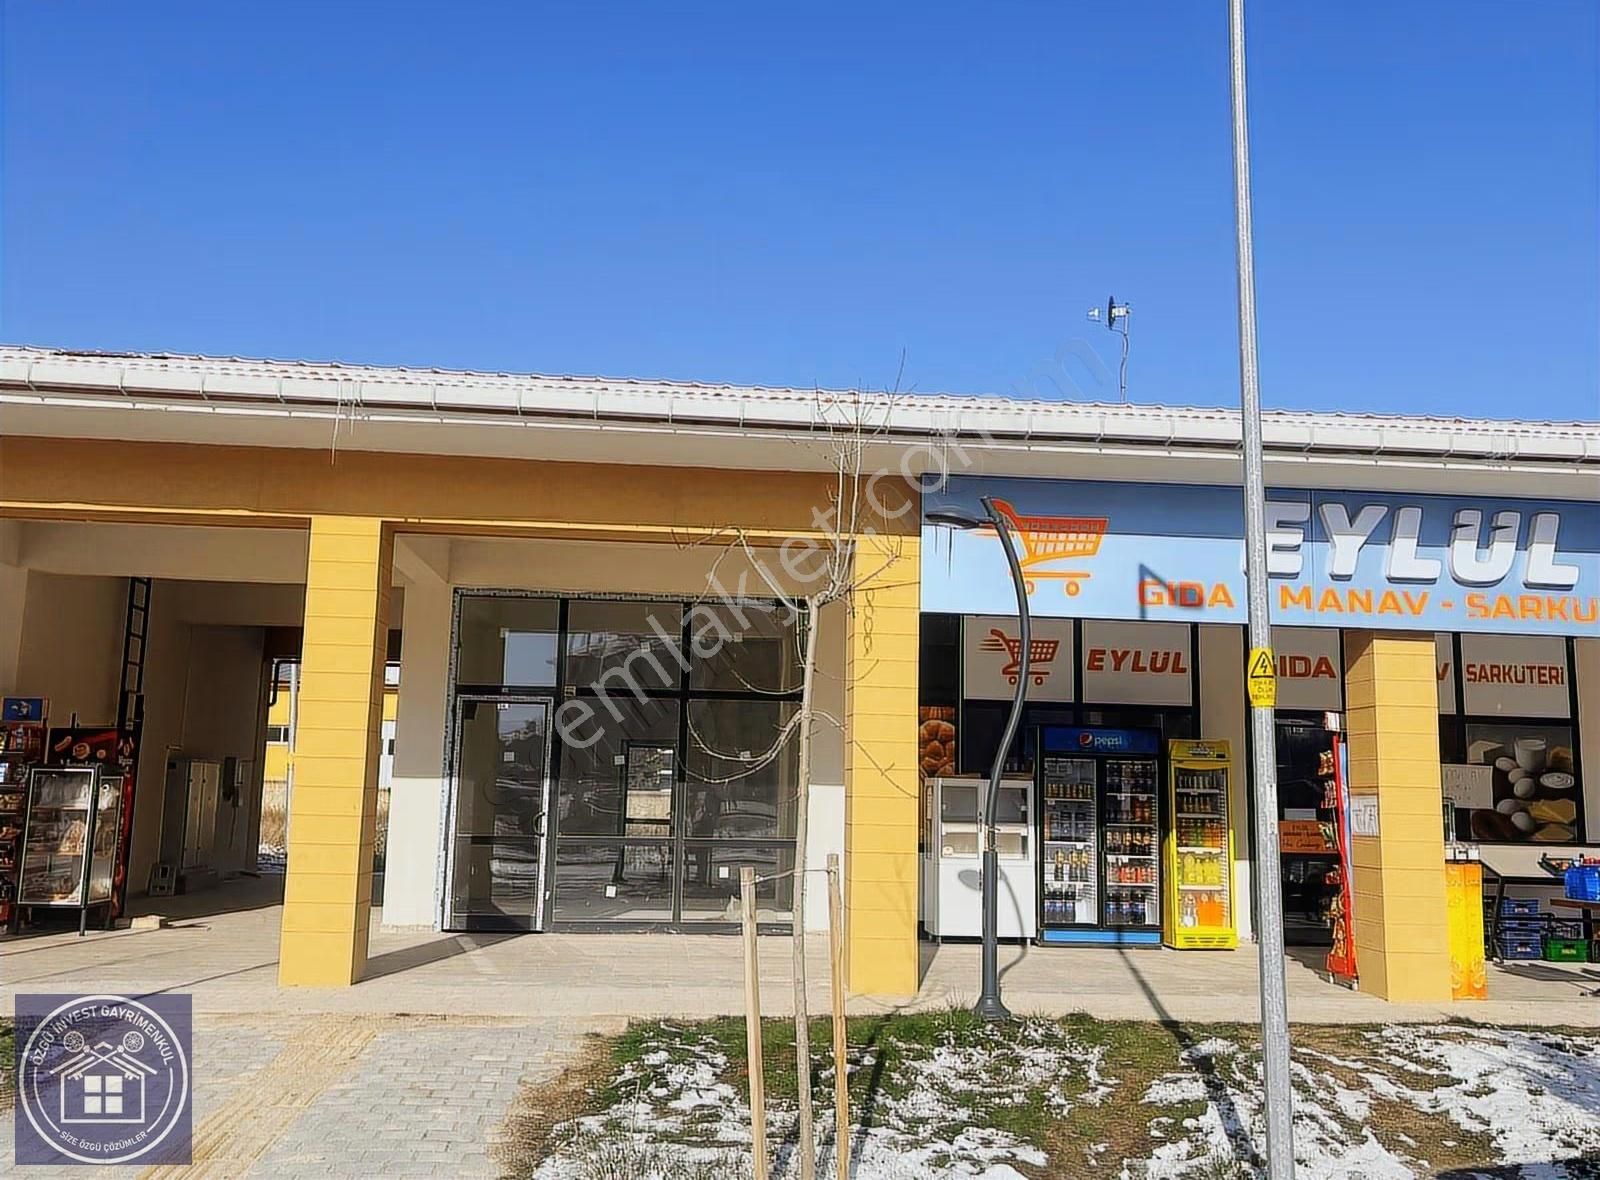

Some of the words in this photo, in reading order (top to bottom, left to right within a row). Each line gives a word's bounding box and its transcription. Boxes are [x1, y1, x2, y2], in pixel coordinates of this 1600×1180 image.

[1138, 577, 1235, 609] GIDA
[1279, 584, 1430, 617] MANAV
[1274, 655, 1337, 679] IDA
[1094, 735, 1122, 748] pepsi
